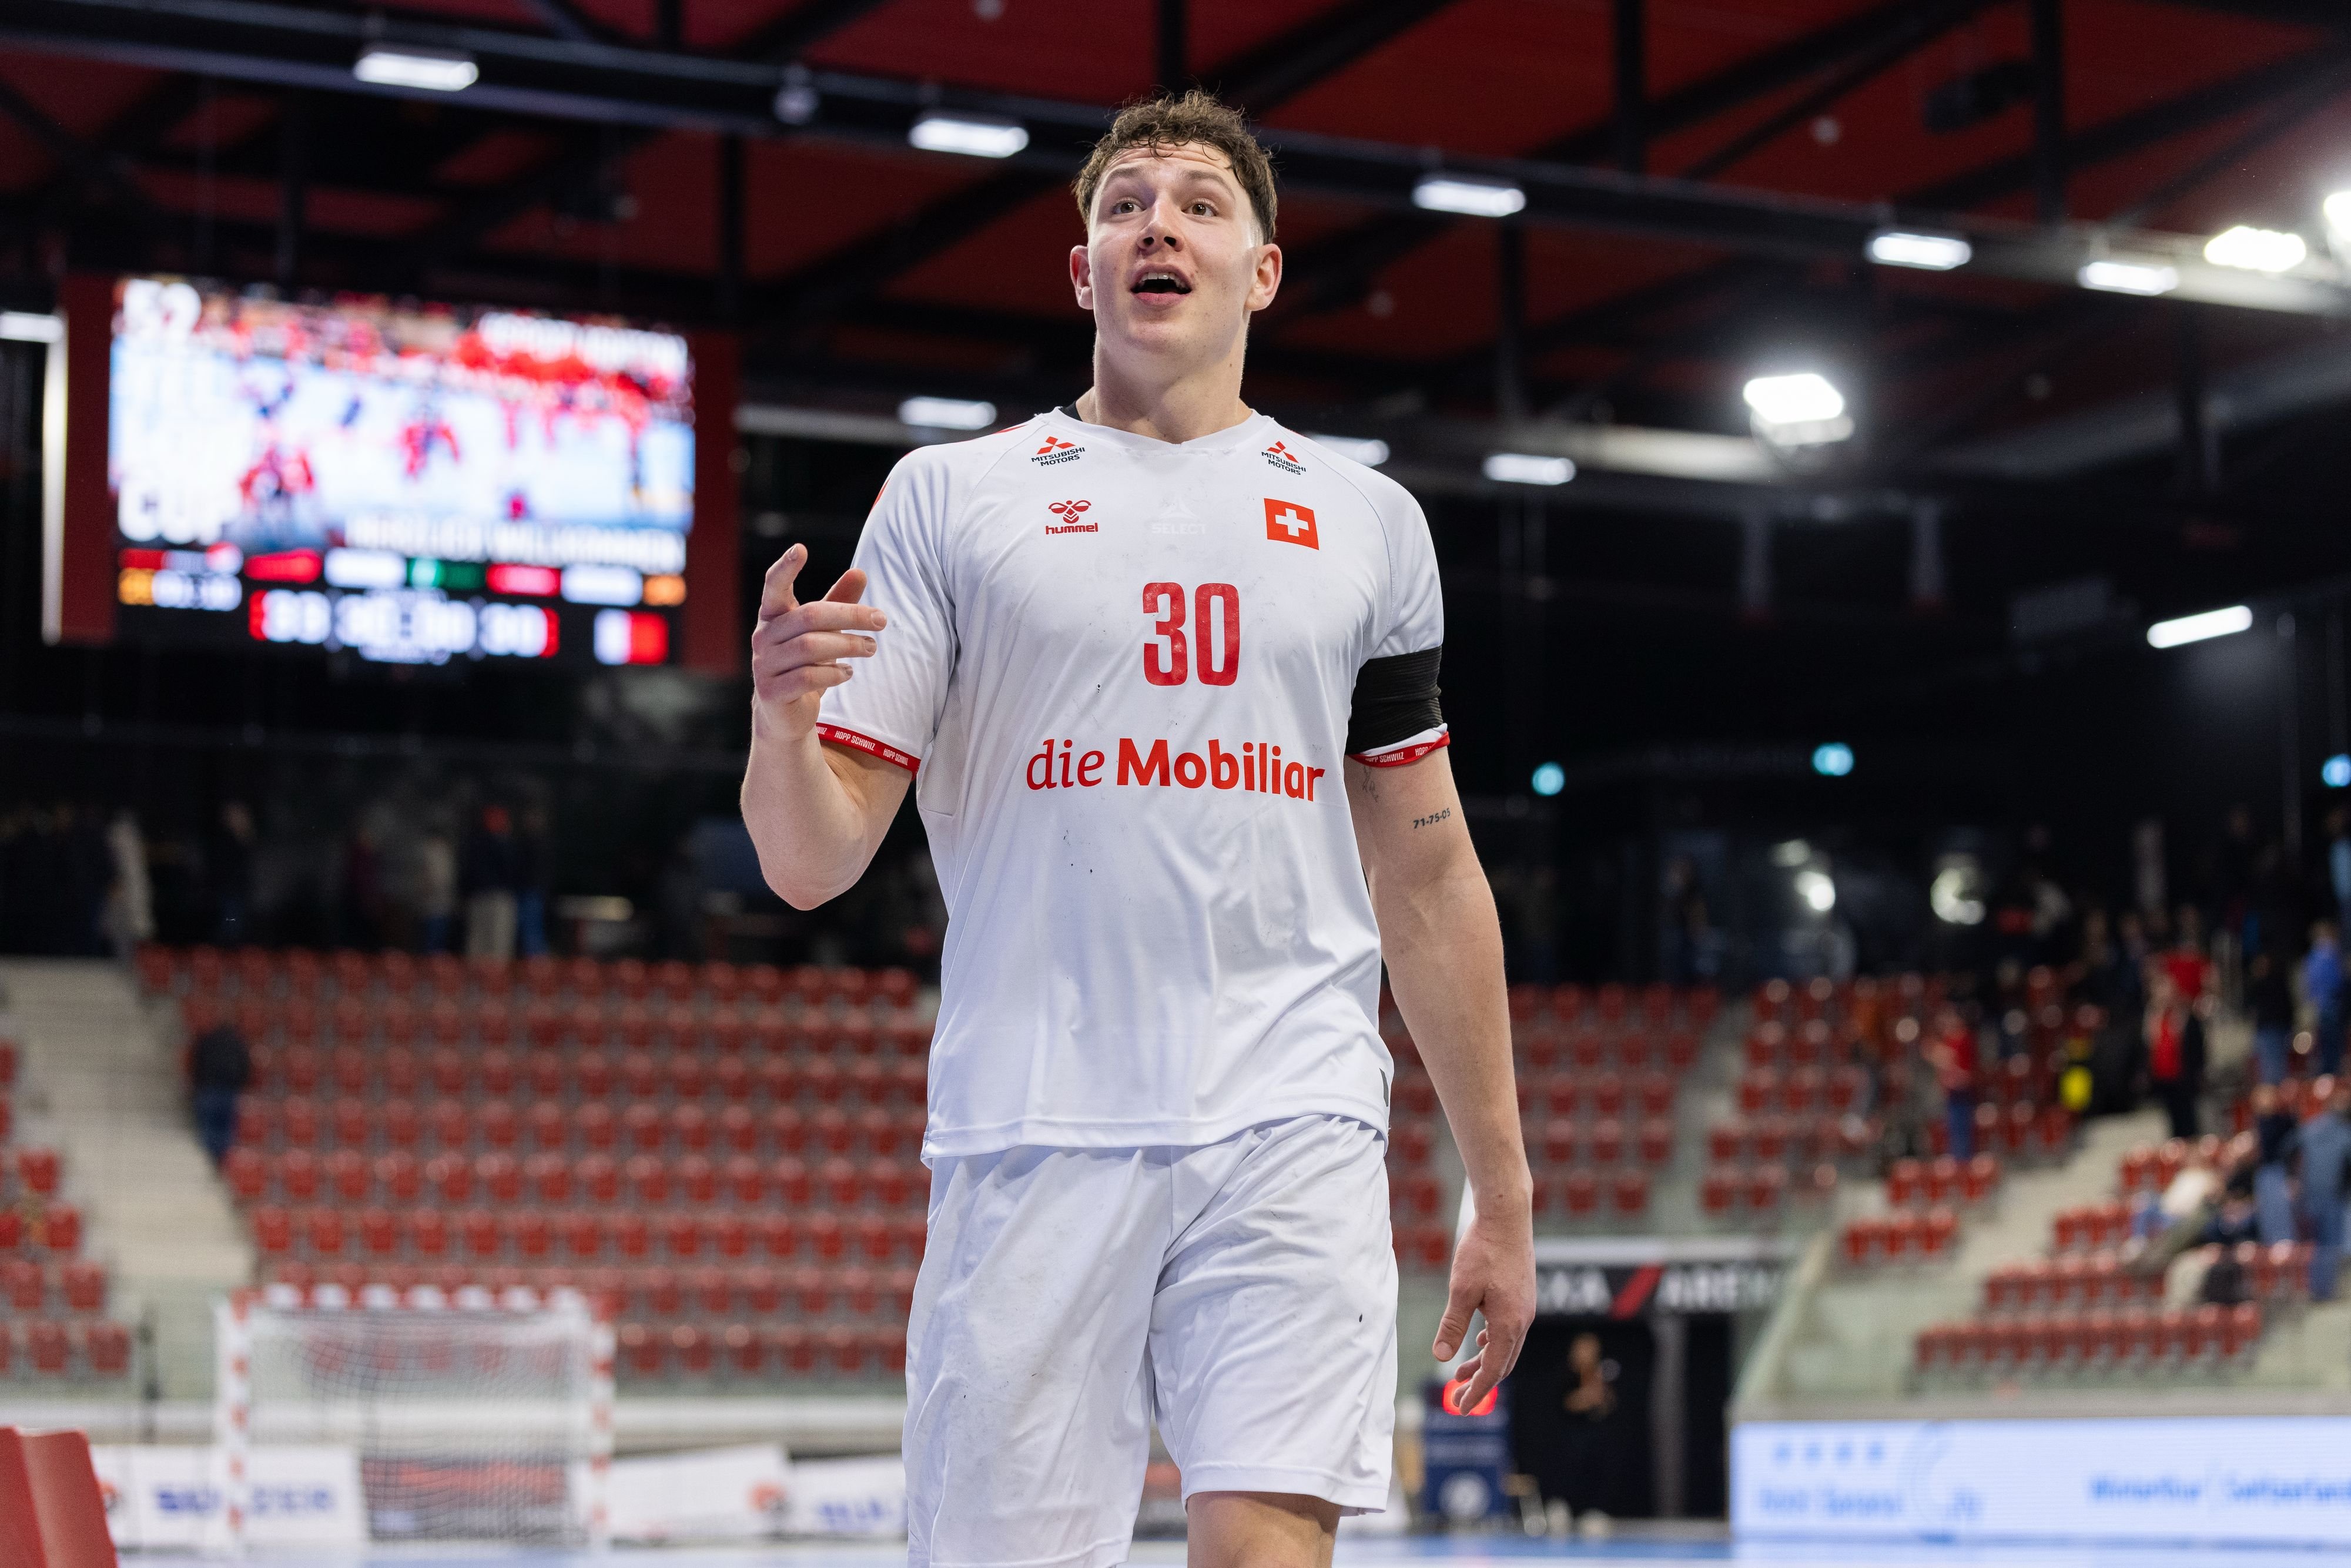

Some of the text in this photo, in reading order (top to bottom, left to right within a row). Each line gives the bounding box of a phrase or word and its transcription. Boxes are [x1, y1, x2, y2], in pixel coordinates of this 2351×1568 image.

[1031, 447, 1086, 462] MITSUBISHI
[1040, 454, 1080, 466] MOTORS
[1261, 451, 1307, 472] MITSUBISHI
[1268, 459, 1301, 475] MOTORS
[1046, 522, 1099, 534] hummel
[1151, 523, 1207, 535] SELECT
[1143, 582, 1240, 686] 30
[834, 731, 876, 751] HOPP SCHWIIZ
[883, 748, 895, 759] HOPP
[1379, 752, 1404, 763] SCHWIIZ
[1026, 738, 1325, 802] die Mobiliar
